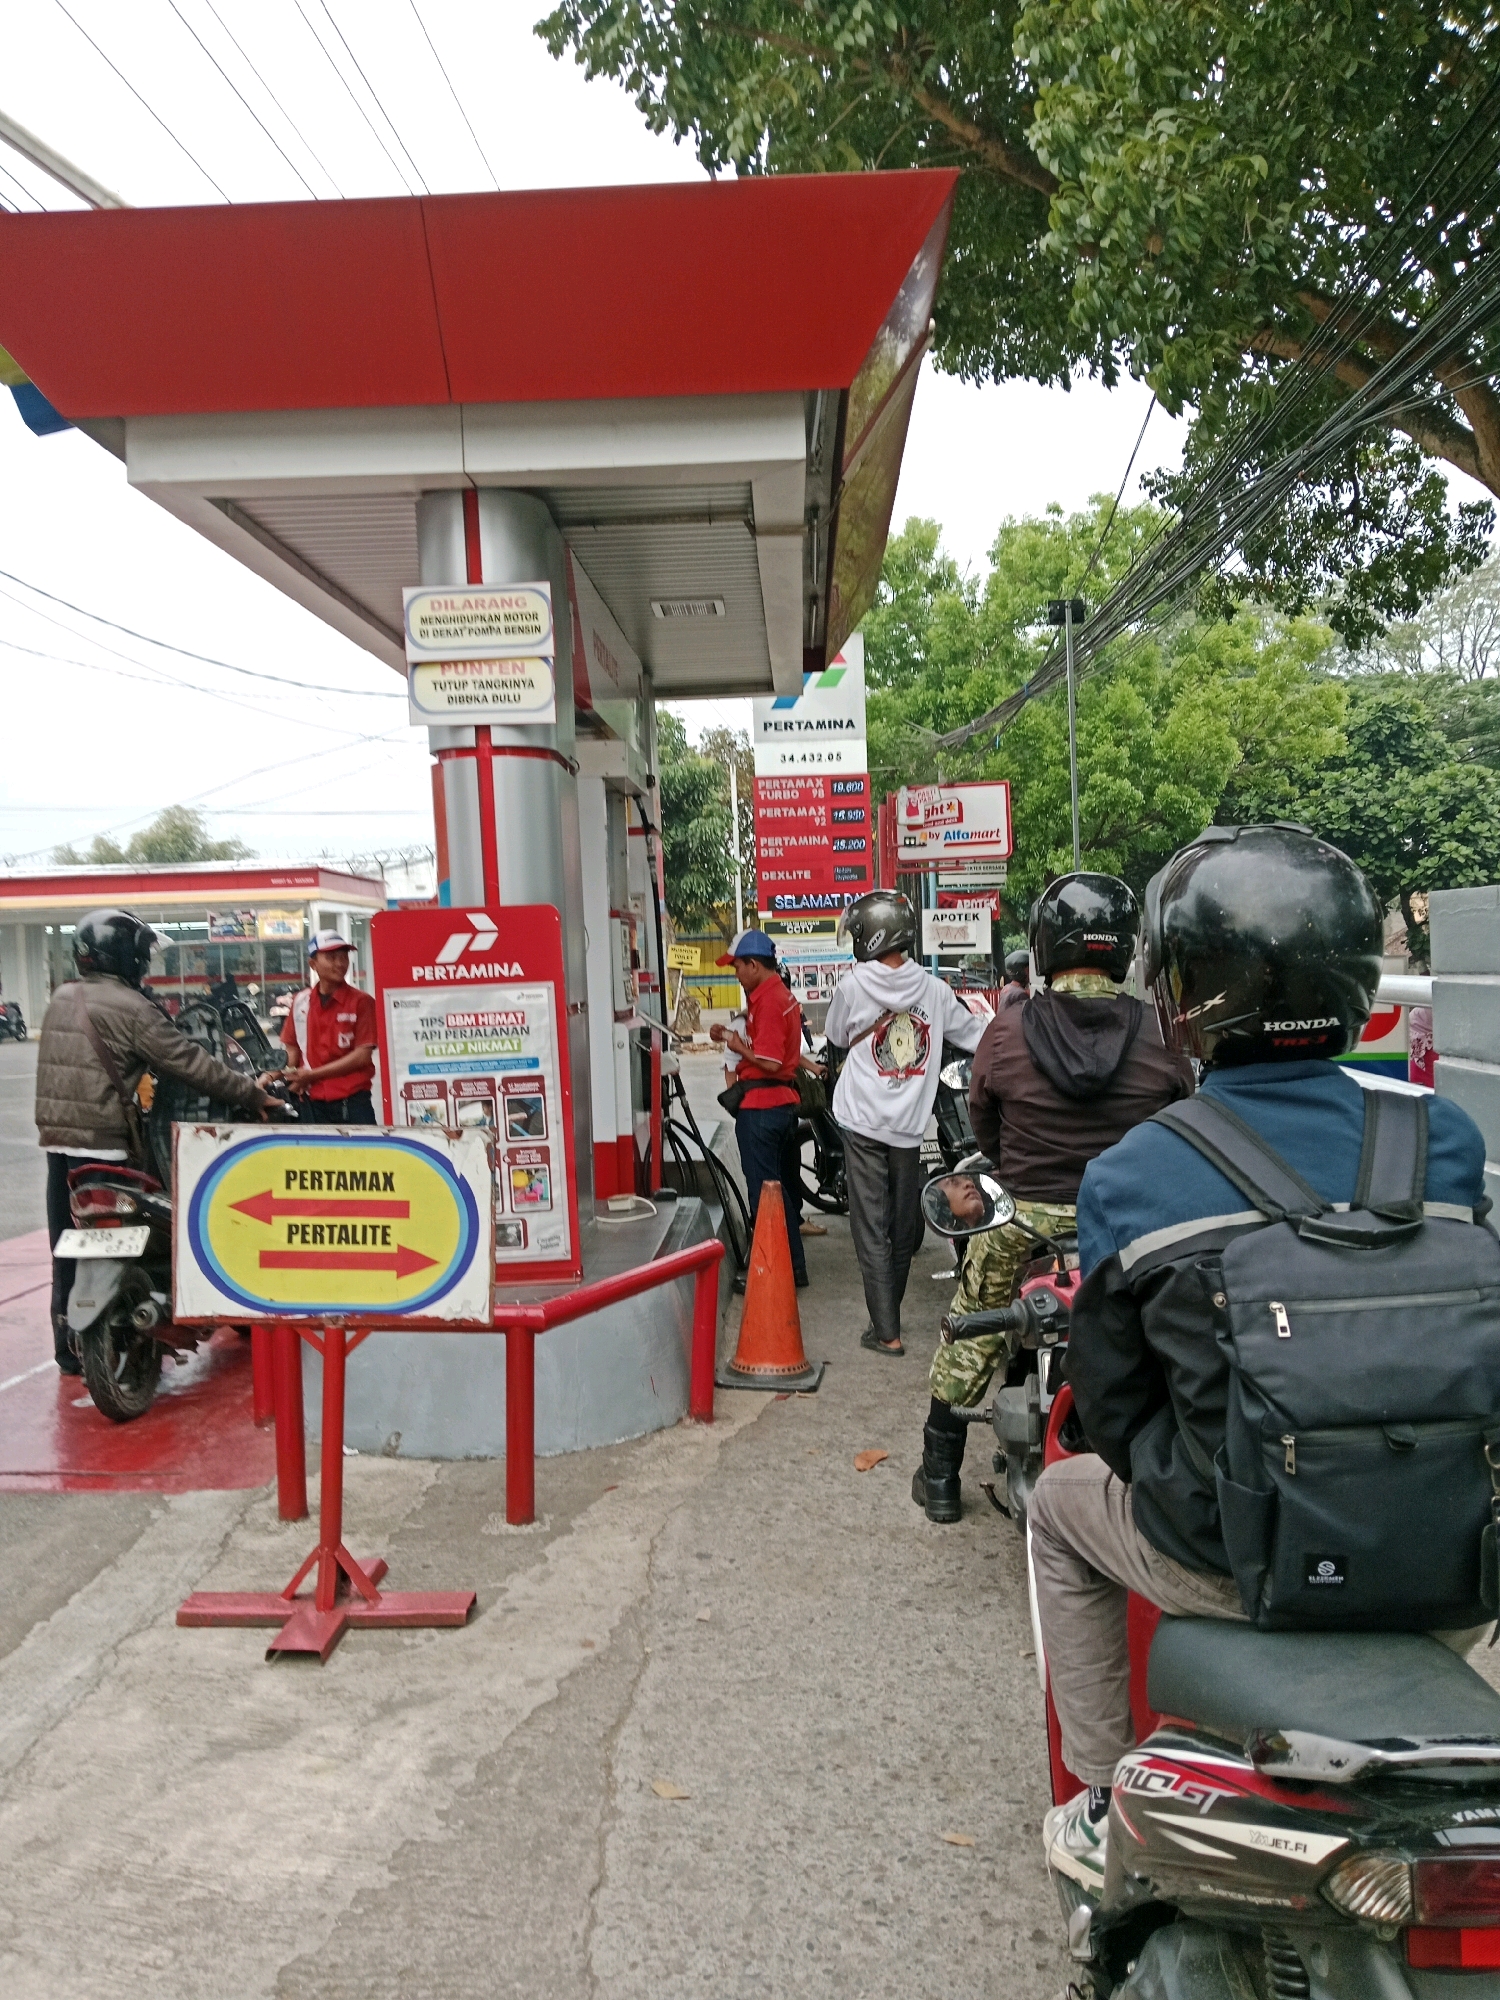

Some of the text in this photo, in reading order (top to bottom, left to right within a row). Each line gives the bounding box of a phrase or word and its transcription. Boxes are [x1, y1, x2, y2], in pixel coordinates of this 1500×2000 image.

[430, 596, 527, 613] DILARANG
[420, 611, 539, 626] MENGHIDUPKAN MOTOR
[419, 624, 541, 639] DI DEKAT POMPA BENSIN
[440, 660, 526, 676] PUNTEN
[432, 677, 535, 692] TUTUP TANGKINYA
[447, 692, 521, 706] DIBUKA DULU
[763, 718, 856, 732] PERTAMINA
[757, 777, 824, 790] PERTAMAX
[758, 789, 800, 801] TURBO
[758, 806, 826, 818] PERTAMAX
[814, 816, 827, 827] 92
[759, 835, 830, 847] PERTAMINA
[929, 828, 1001, 842] by Alfamart
[761, 847, 784, 858] DEX
[762, 869, 812, 881] DEXLITE
[774, 893, 841, 910] SELAMAT
[956, 897, 998, 911] APOTEK
[932, 913, 980, 923] APOTEK
[786, 924, 814, 934] CCTV
[1083, 933, 1118, 943] HONDA
[412, 962, 525, 982] PERTAMINA
[419, 1011, 524, 1028] TIPS BBM HEMAT
[1263, 1017, 1341, 1032] HONDA
[413, 1025, 531, 1042] TAPI PERJALANAN
[426, 1039, 520, 1056] TETAP NIKMAT
[285, 1169, 396, 1193] PERTAMAX
[287, 1223, 392, 1246] PERTALITE
